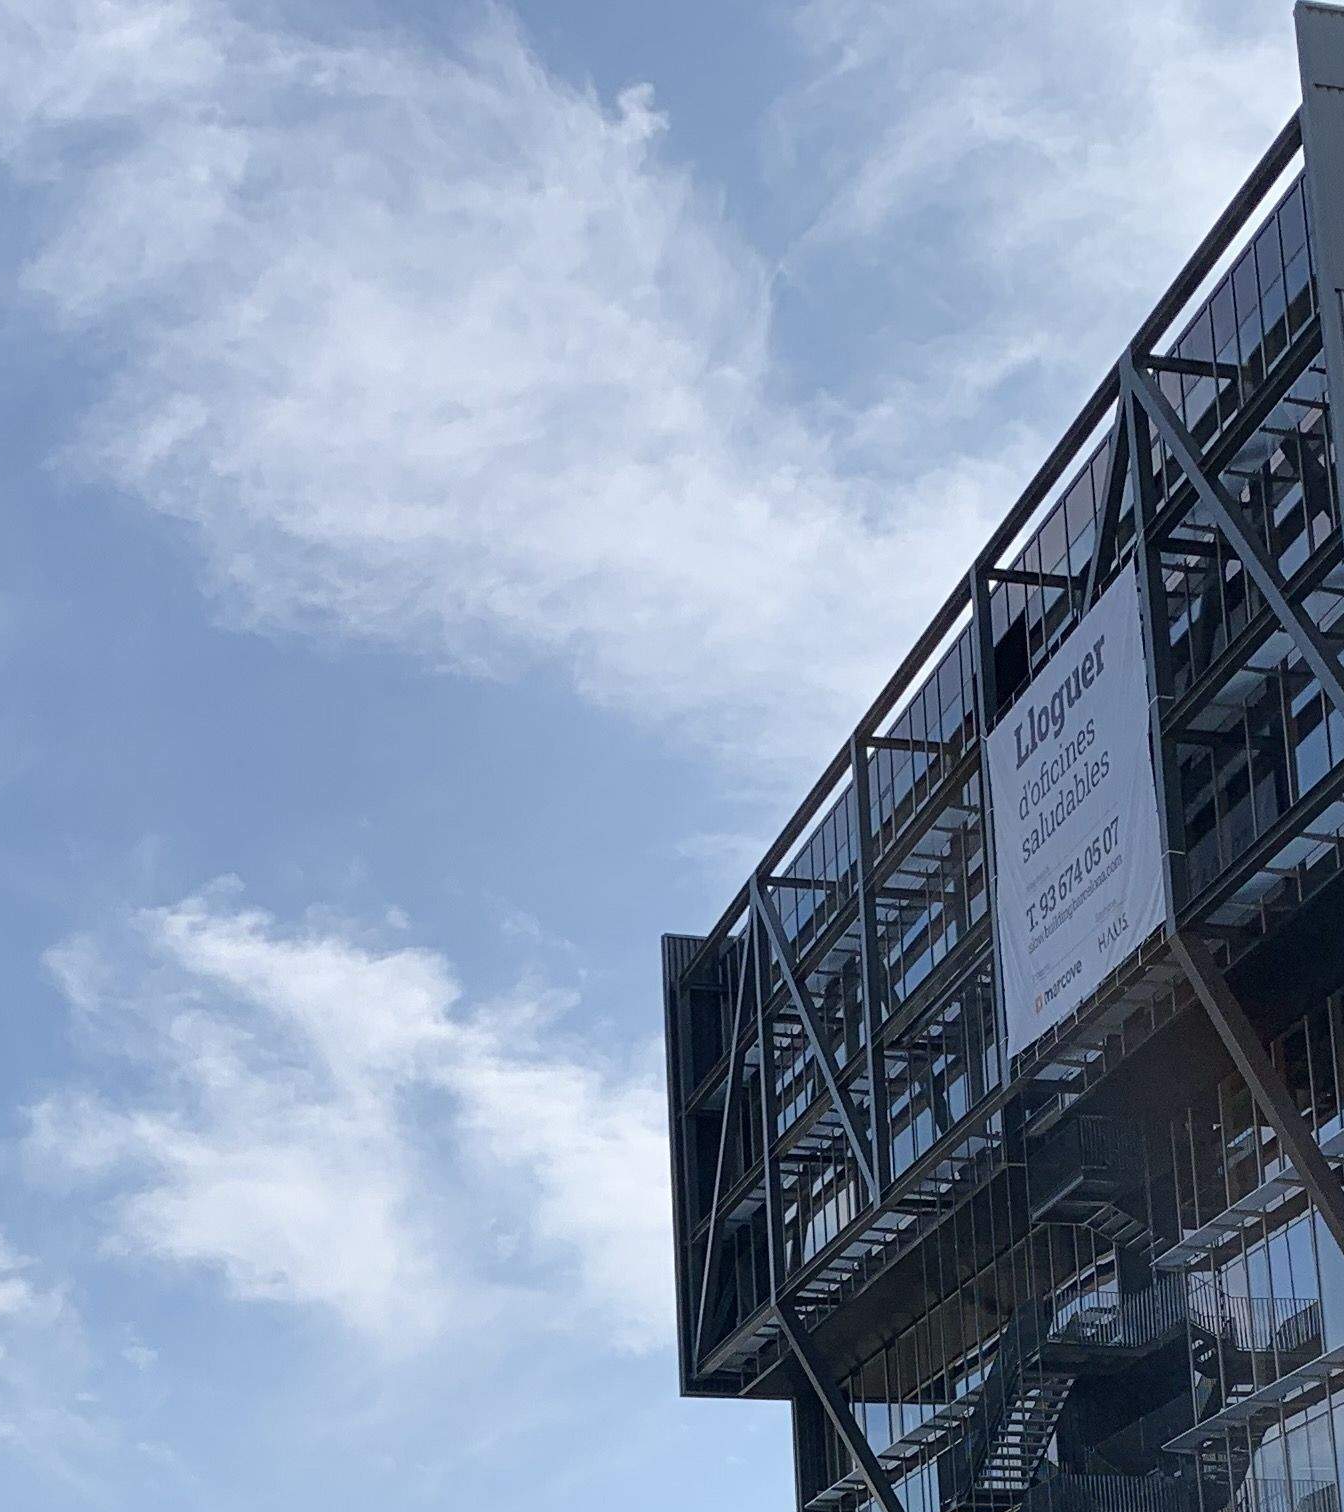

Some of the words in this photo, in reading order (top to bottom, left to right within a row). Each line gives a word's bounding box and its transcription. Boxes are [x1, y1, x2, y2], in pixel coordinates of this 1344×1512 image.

[1014, 634, 1105, 771] Lloguer
[1019, 718, 1095, 820] d'oficines
[1022, 750, 1110, 863] saludables
[1026, 903, 1039, 932] T.
[1039, 884, 1057, 920] 93
[1058, 857, 1083, 900] 674
[1084, 836, 1101, 874] 05
[1103, 815, 1119, 855] 07
[1043, 960, 1083, 1005] marcove
